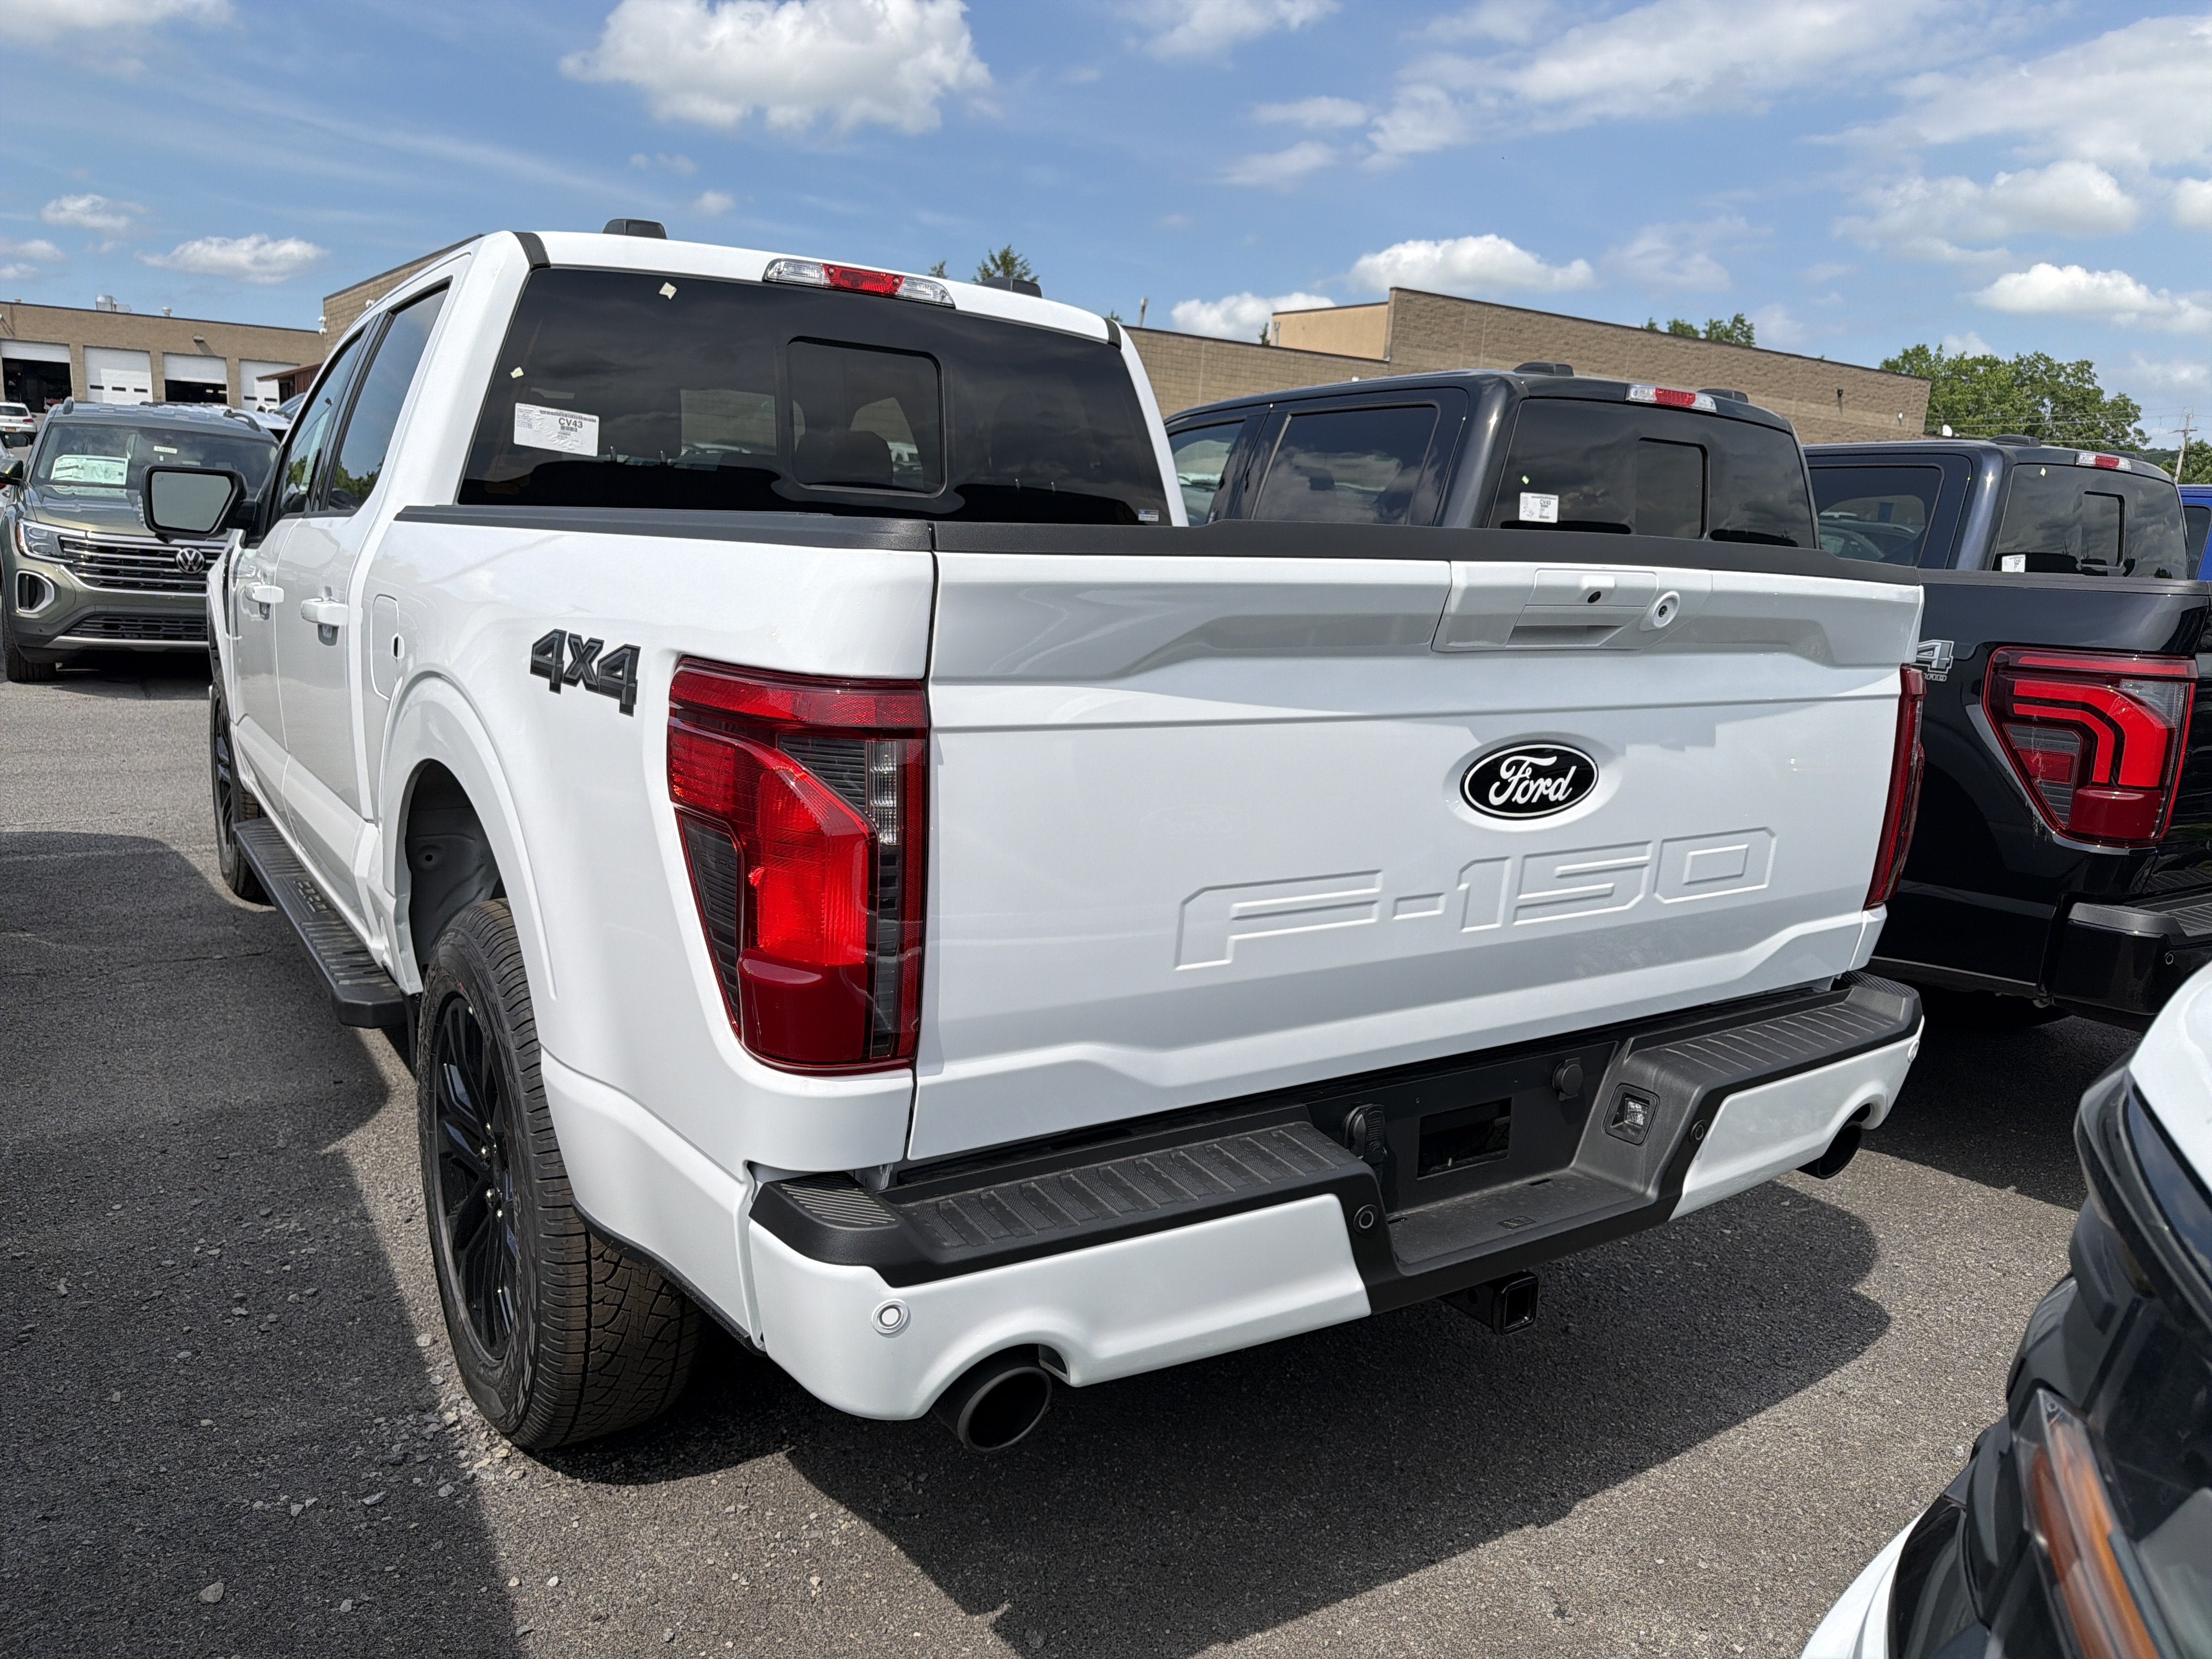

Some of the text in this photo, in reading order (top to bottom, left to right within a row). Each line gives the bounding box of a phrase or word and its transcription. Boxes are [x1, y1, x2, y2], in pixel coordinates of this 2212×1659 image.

[558, 417, 583, 428] CV43
[1488, 755, 1577, 806] Ford
[1172, 826, 1778, 973] F-150
